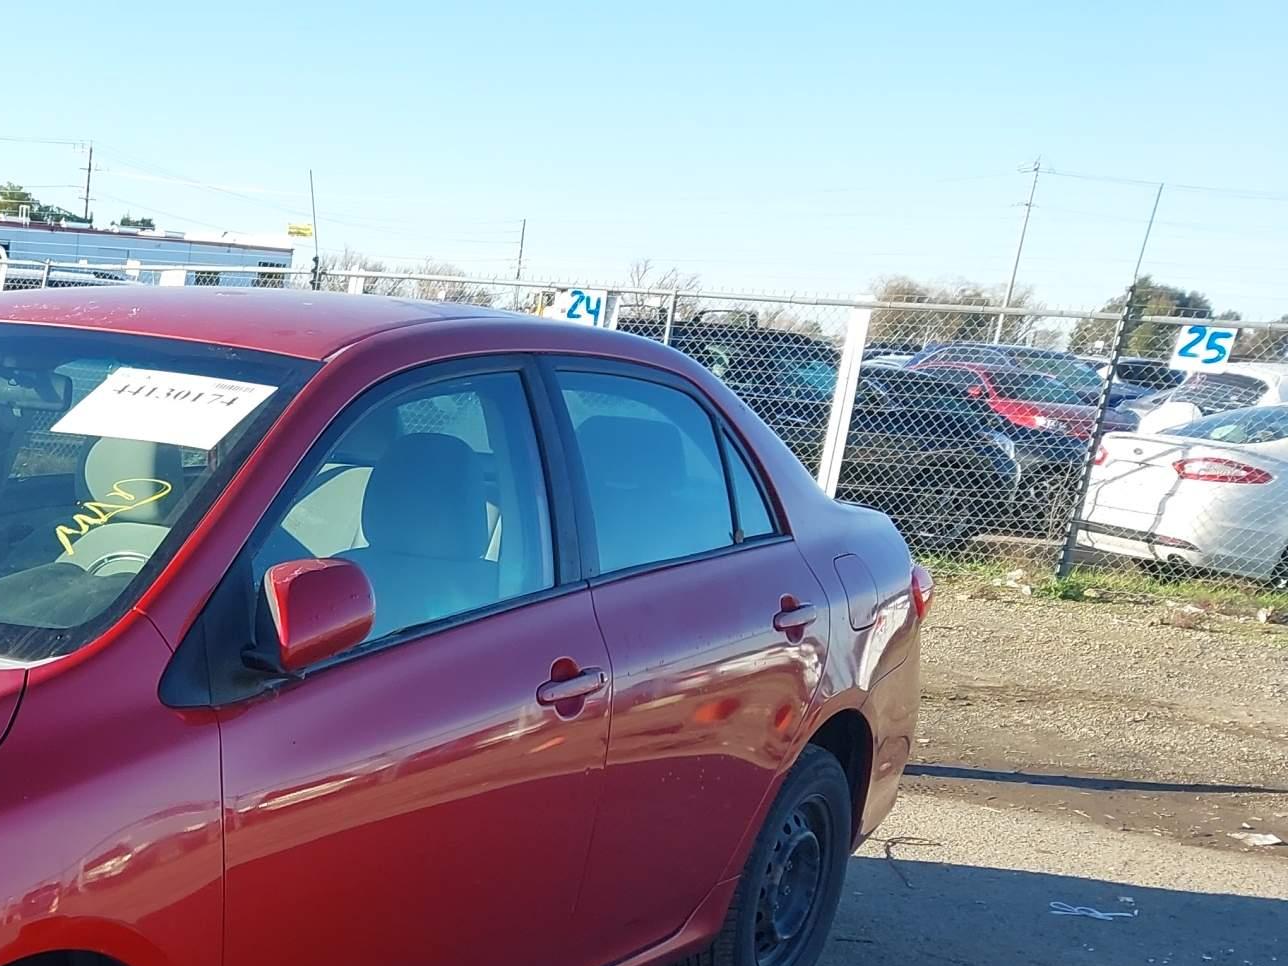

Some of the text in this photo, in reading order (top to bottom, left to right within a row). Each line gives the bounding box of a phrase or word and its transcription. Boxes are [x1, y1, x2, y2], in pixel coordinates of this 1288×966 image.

[566, 290, 602, 326] 24
[1178, 325, 1233, 364] 25
[112, 383, 240, 407] 44130174
